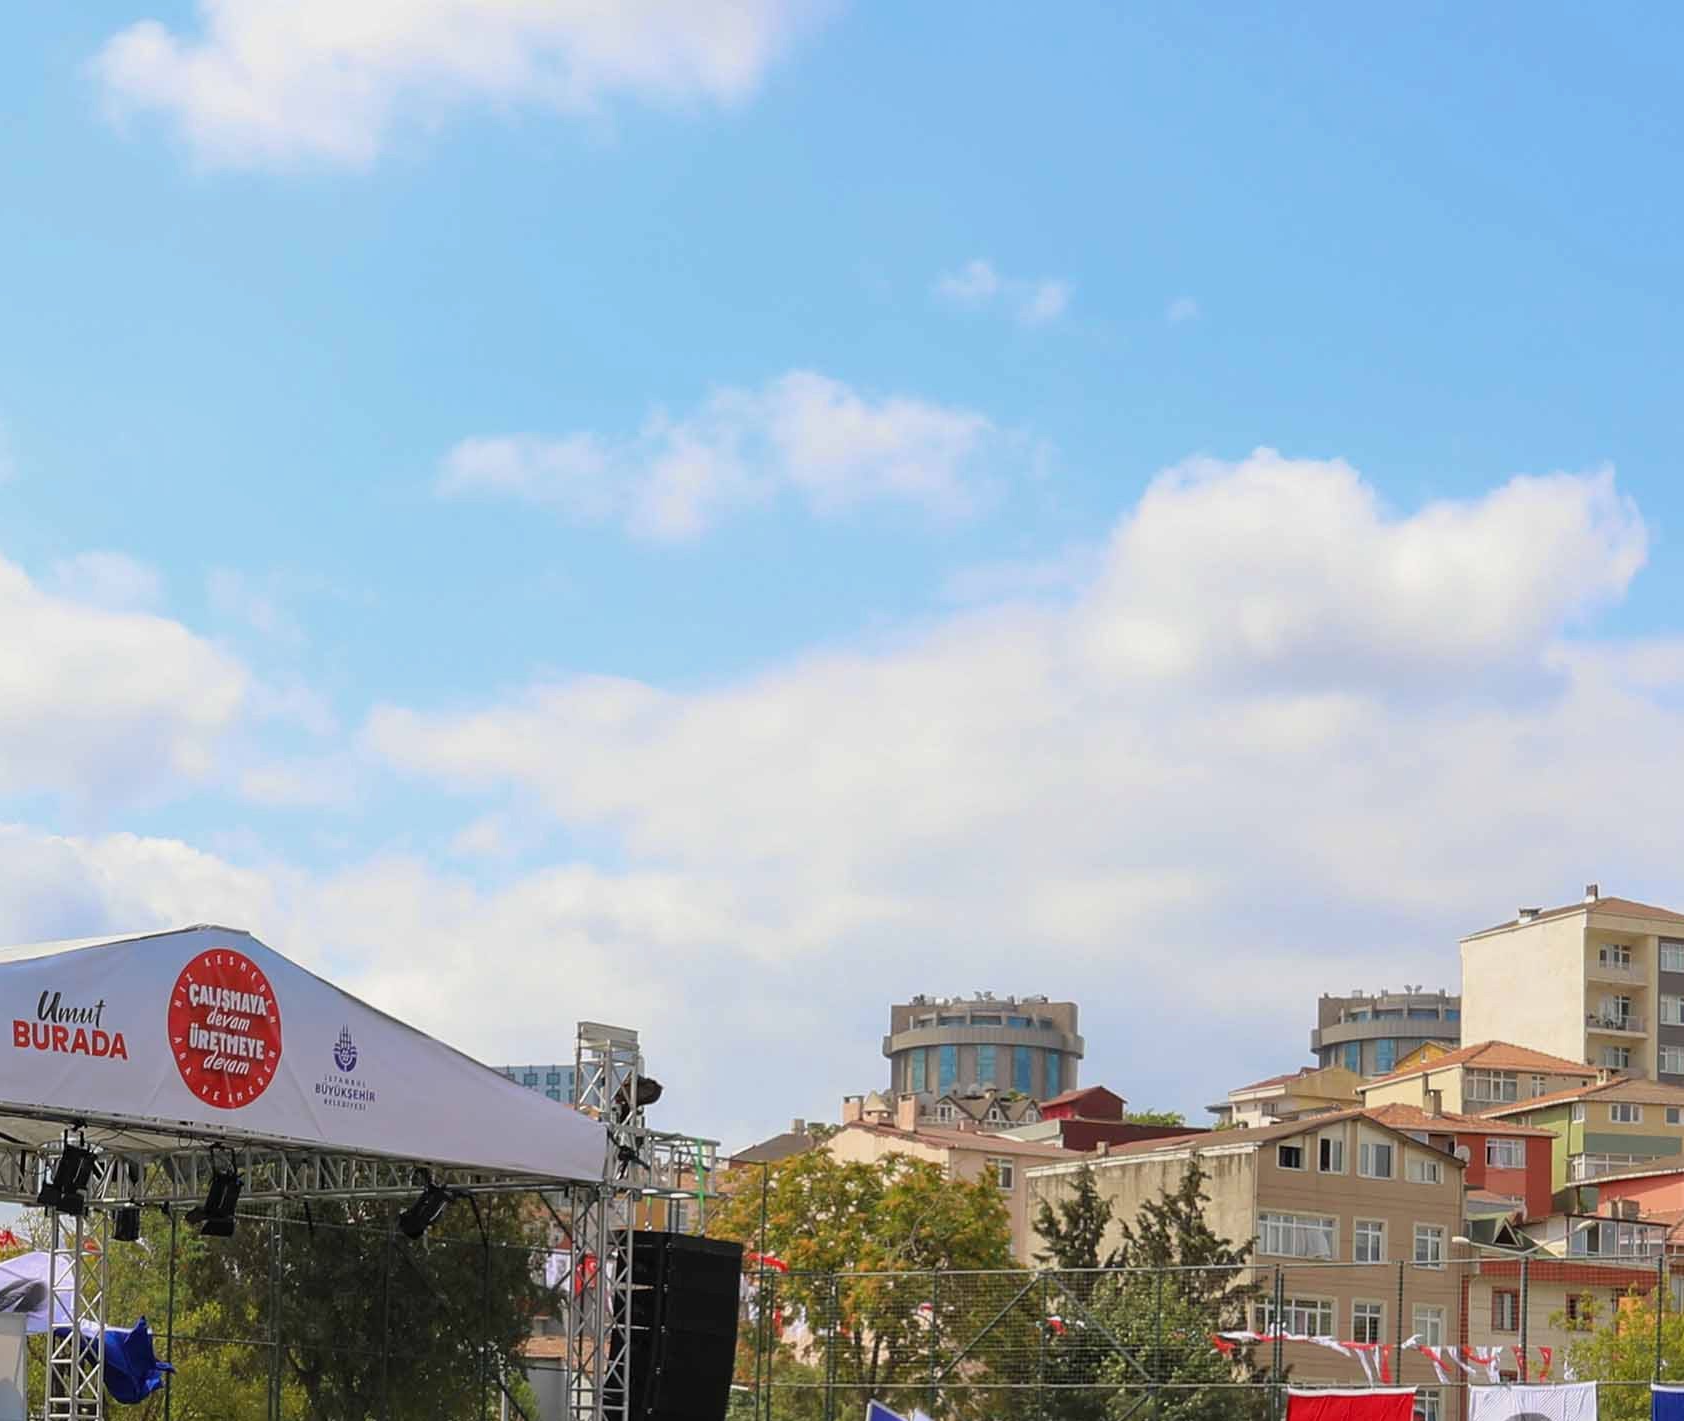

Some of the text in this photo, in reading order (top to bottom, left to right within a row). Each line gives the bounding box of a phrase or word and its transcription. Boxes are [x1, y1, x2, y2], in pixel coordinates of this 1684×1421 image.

[37, 990, 106, 1027] Umut
[189, 983, 267, 1016] ÇALIŞMAYA
[206, 1006, 251, 1032] devam
[12, 1020, 128, 1061] BURADA
[189, 1023, 265, 1060] ÜRETMEYE
[203, 1050, 250, 1075] devam
[315, 1082, 376, 1102] BÜYÜKŞEHİR
